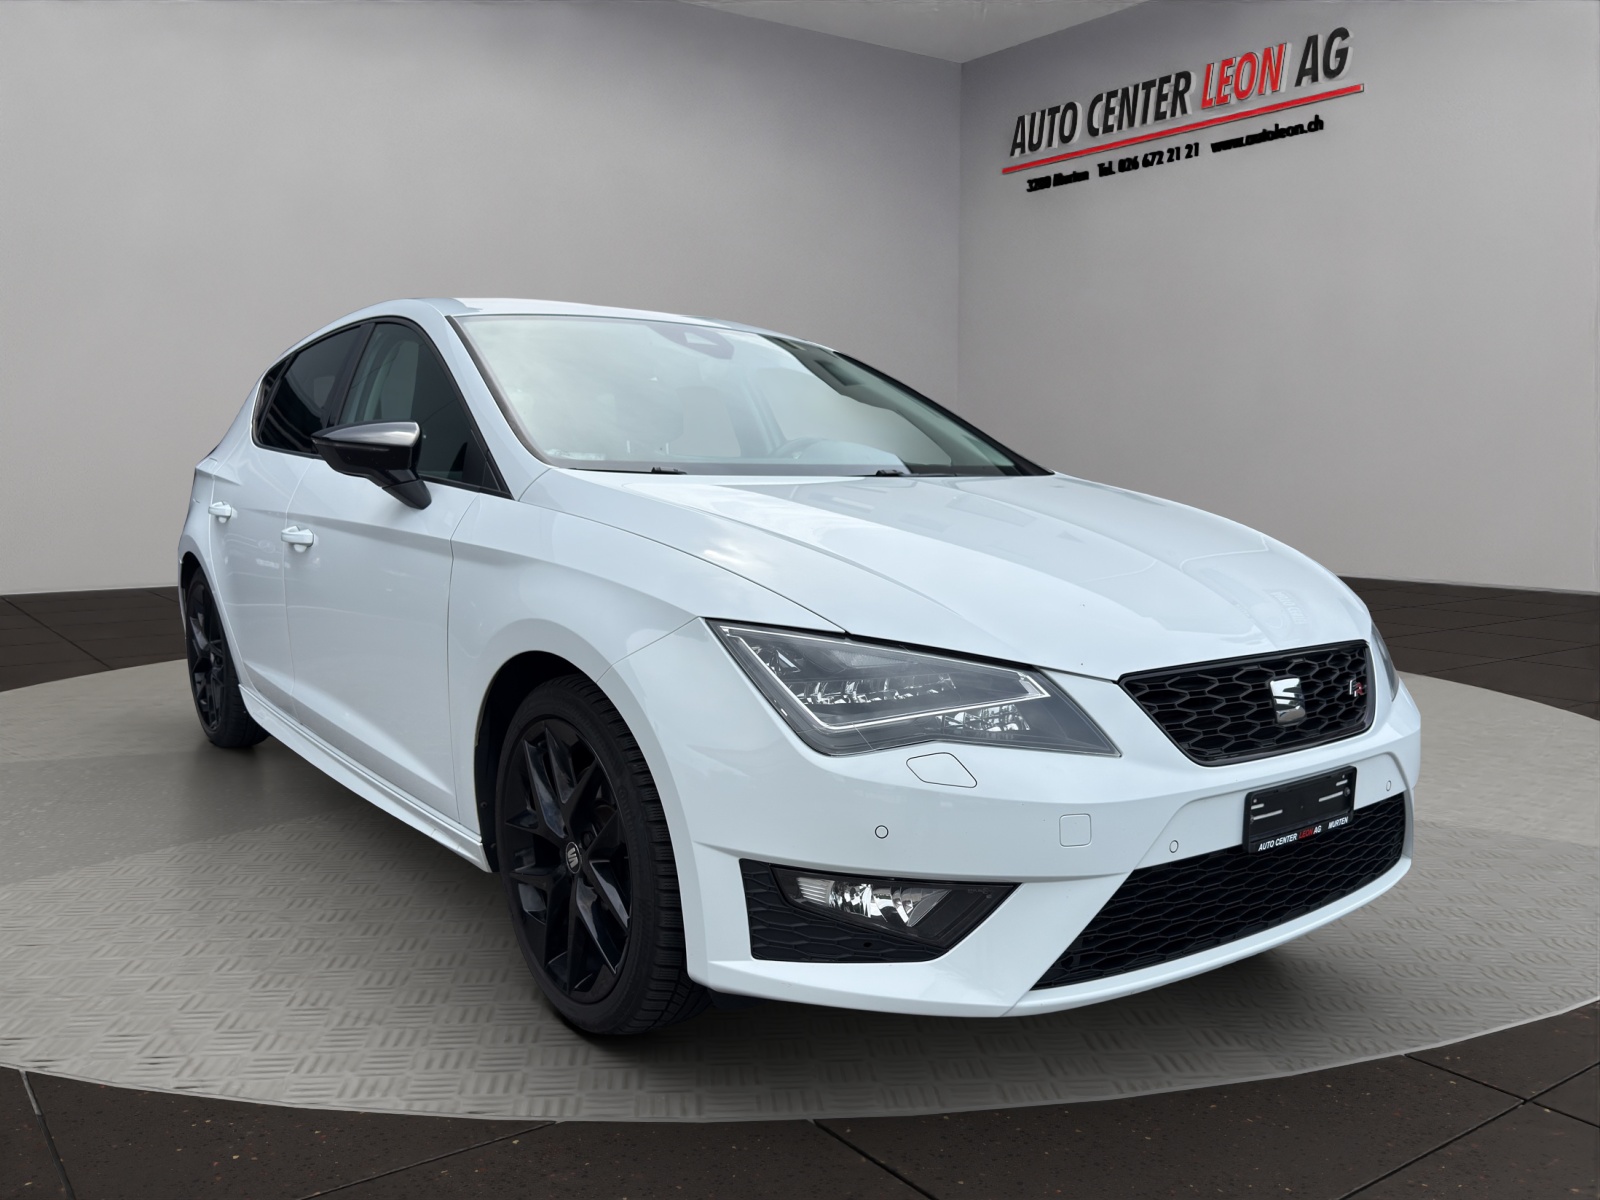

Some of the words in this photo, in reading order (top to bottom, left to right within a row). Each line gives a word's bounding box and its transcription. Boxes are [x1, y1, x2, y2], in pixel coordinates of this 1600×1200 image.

[1010, 101, 1080, 157] AUTO
[1087, 70, 1194, 137] CENTER
[1201, 43, 1290, 110] LEON
[1295, 27, 1353, 87] AG
[1141, 150, 1164, 168] 672
[1166, 146, 1181, 163] 21
[1184, 142, 1200, 159] 21
[1258, 840, 1275, 852] AUTO
[1275, 833, 1298, 847] CENTER
[1299, 828, 1314, 839] LEON
[1313, 825, 1322, 835] AG
[1328, 816, 1349, 830] MURTEN
